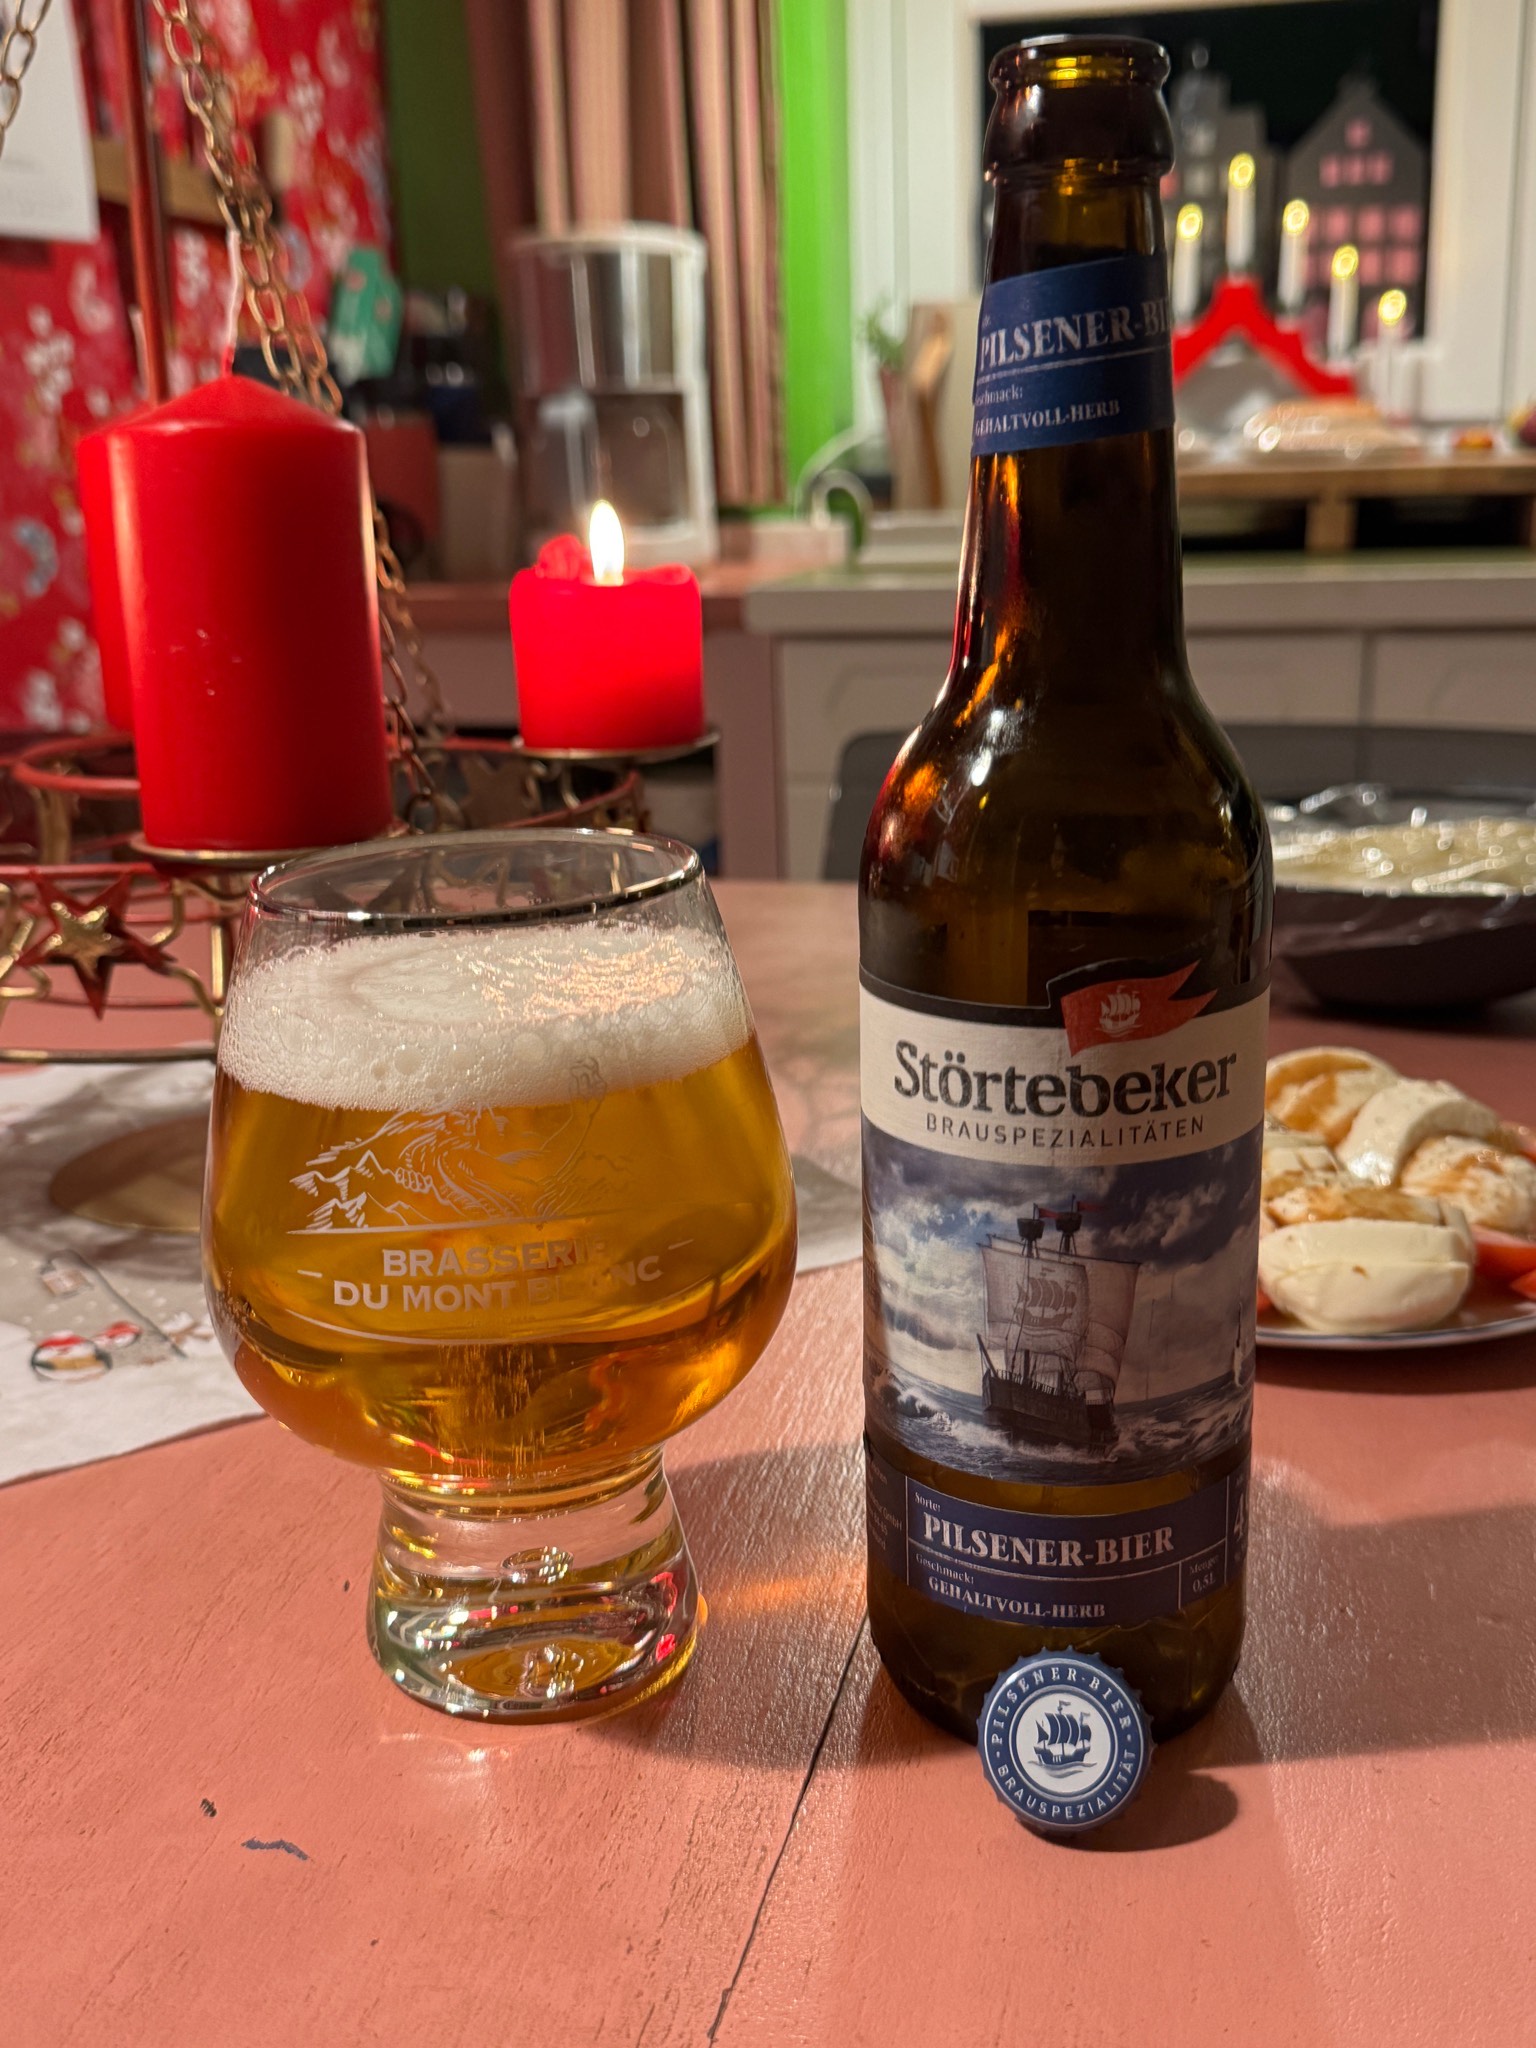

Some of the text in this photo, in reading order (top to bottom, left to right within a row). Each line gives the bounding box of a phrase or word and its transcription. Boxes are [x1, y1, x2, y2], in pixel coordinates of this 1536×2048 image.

[979, 298, 1171, 371] PILSENER-BI
[975, 400, 1120, 436] GEHALTVOLL-HERB
[894, 1040, 1237, 1118] Störtebeker
[926, 1112, 1204, 1149] BRAUSPEZIALITÄTEN
[333, 1280, 389, 1310] DU
[403, 1279, 515, 1313] MONT
[914, 1491, 940, 1513] Sorte:
[922, 1511, 1175, 1567] PILSENER-BIER
[916, 1552, 974, 1585] Geschmack:
[928, 1576, 1105, 1618] GEHALTVOLL-HERB
[997, 1749, 1137, 1820] BRAUSPEZIALITÄT
